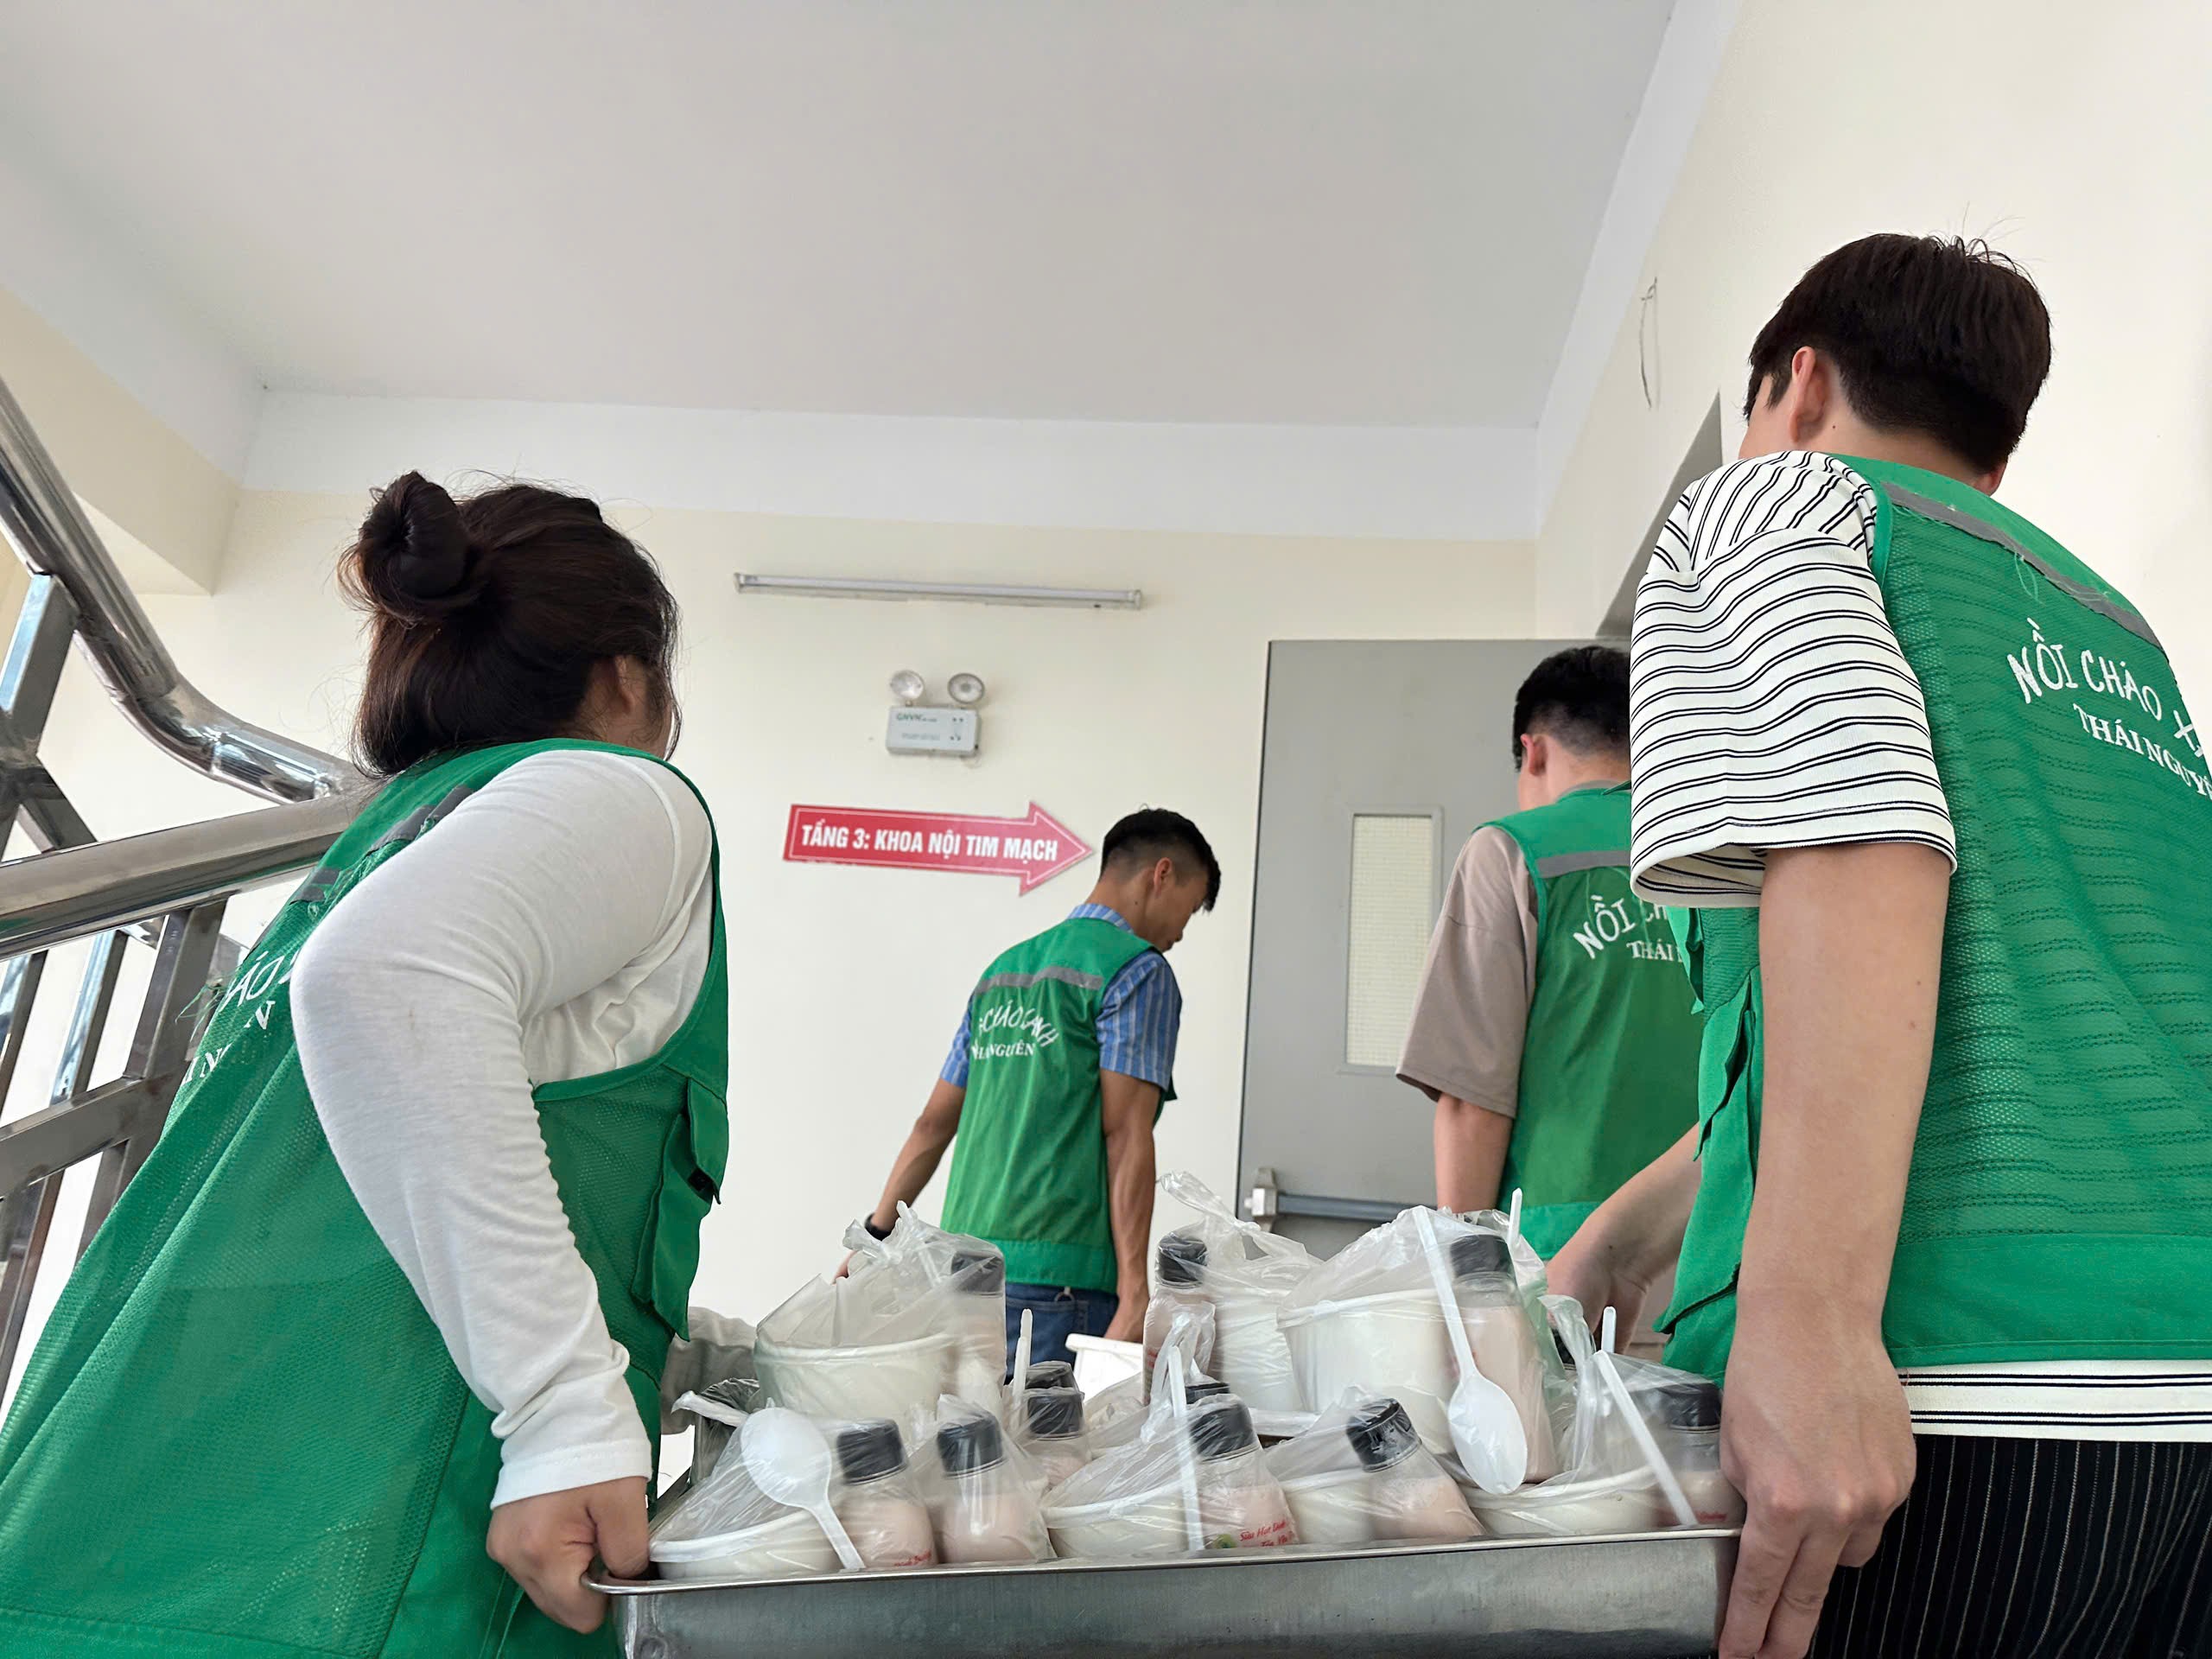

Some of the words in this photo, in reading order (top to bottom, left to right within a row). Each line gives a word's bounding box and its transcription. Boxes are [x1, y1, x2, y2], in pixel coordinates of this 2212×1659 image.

[2006, 617, 2078, 704] NỒI
[2081, 650, 2162, 721] CHÁO
[2073, 703, 2144, 755] THÁI
[2143, 736, 2212, 800] NGUY
[852, 828, 870, 849] 3:
[874, 829, 924, 853] KHOA
[928, 830, 961, 860] NỘI
[966, 835, 999, 858] TIM
[1002, 837, 1058, 865] MẠCH
[1573, 894, 1637, 959] NỒI
[1626, 938, 1674, 962] THÁI
[218, 950, 286, 1013] ÁO
